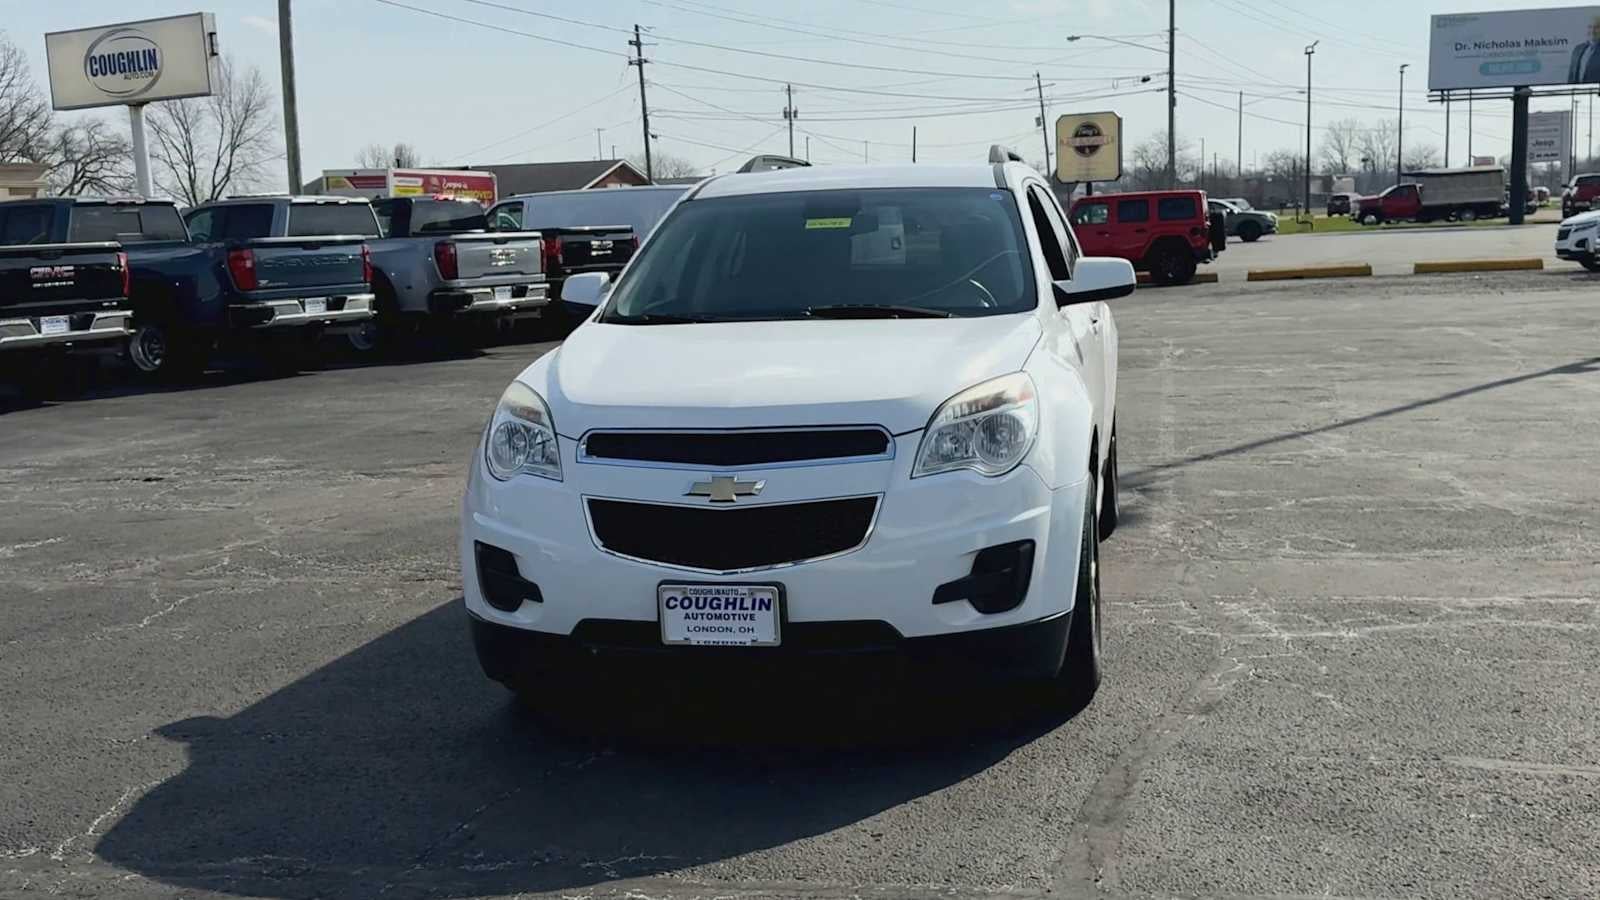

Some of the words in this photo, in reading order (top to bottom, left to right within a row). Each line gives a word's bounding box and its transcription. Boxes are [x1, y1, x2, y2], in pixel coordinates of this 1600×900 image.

[1455, 42, 1471, 51] Dr.
[1473, 38, 1521, 50] Nicholas
[1525, 36, 1569, 48] Maksim
[89, 48, 158, 77] COUGHLIN
[665, 596, 773, 612] COUGHLIN
[683, 611, 757, 622] AUTOMOTIVE
[686, 625, 736, 634] LONDON,
[738, 626, 755, 634] OH
